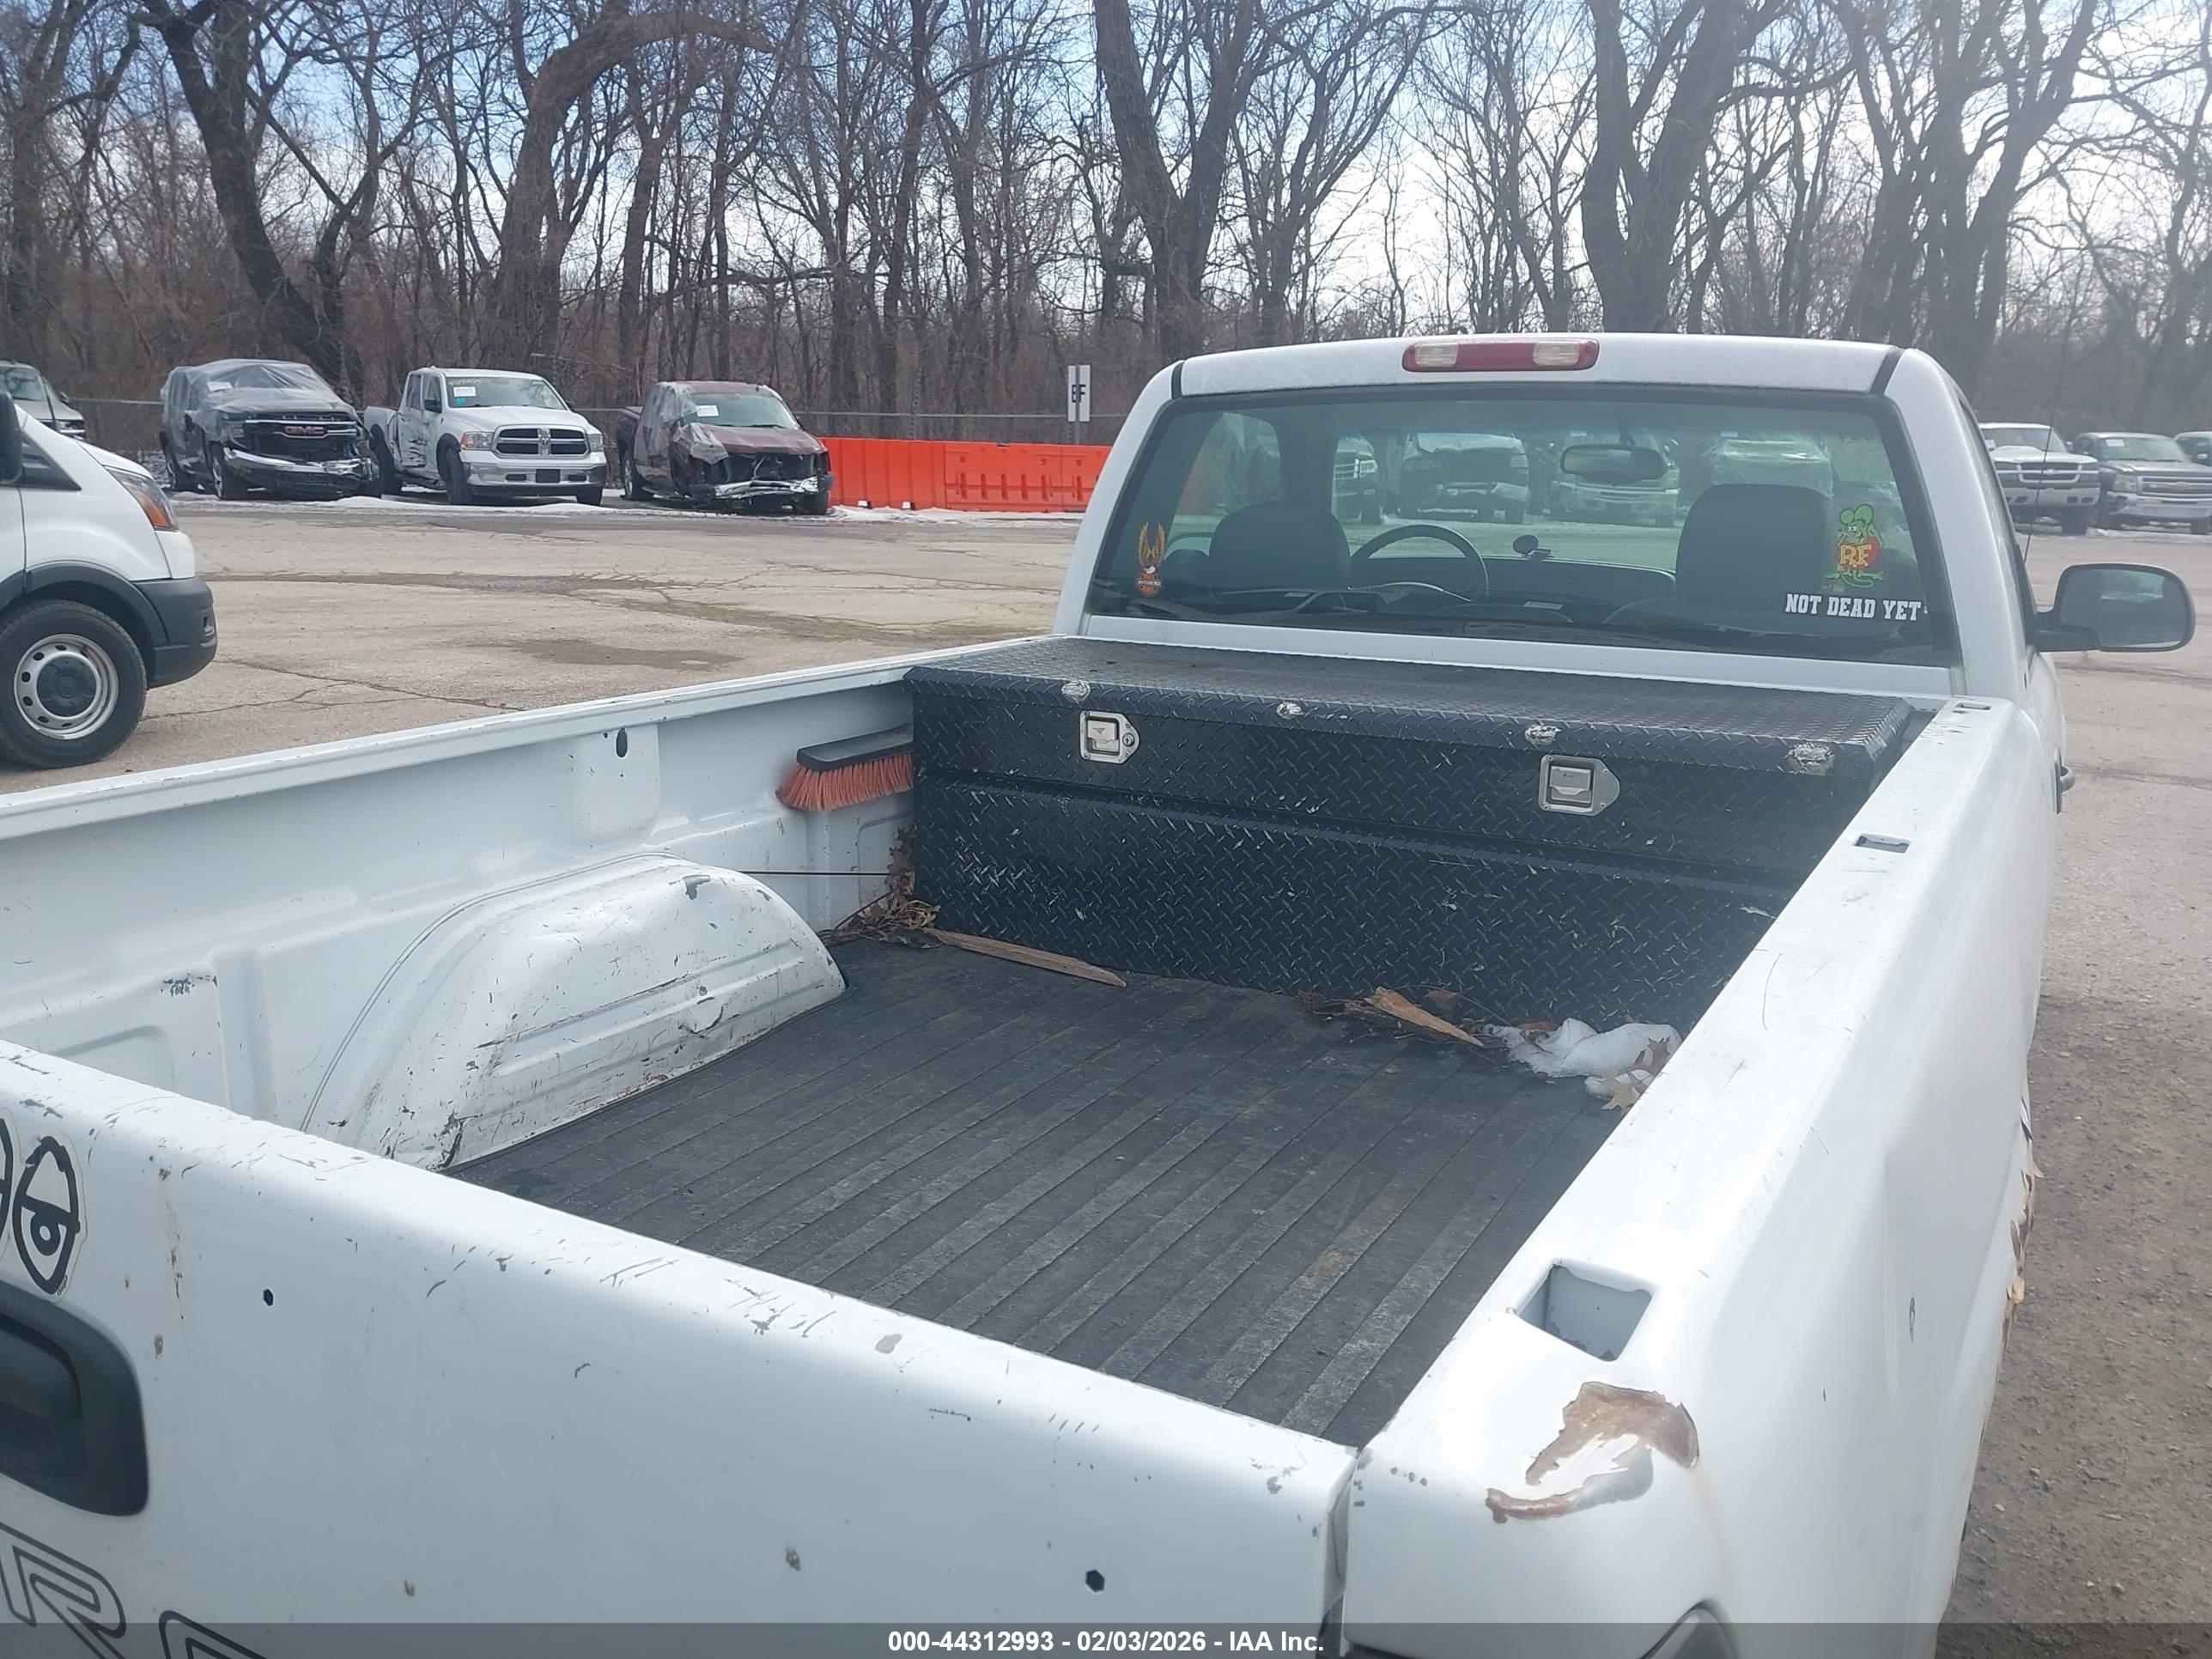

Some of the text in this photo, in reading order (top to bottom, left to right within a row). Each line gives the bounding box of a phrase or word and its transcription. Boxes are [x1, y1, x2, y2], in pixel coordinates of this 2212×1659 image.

[283, 425, 325, 434] GMC
[1784, 593, 1922, 621] NOT DEAD YET
